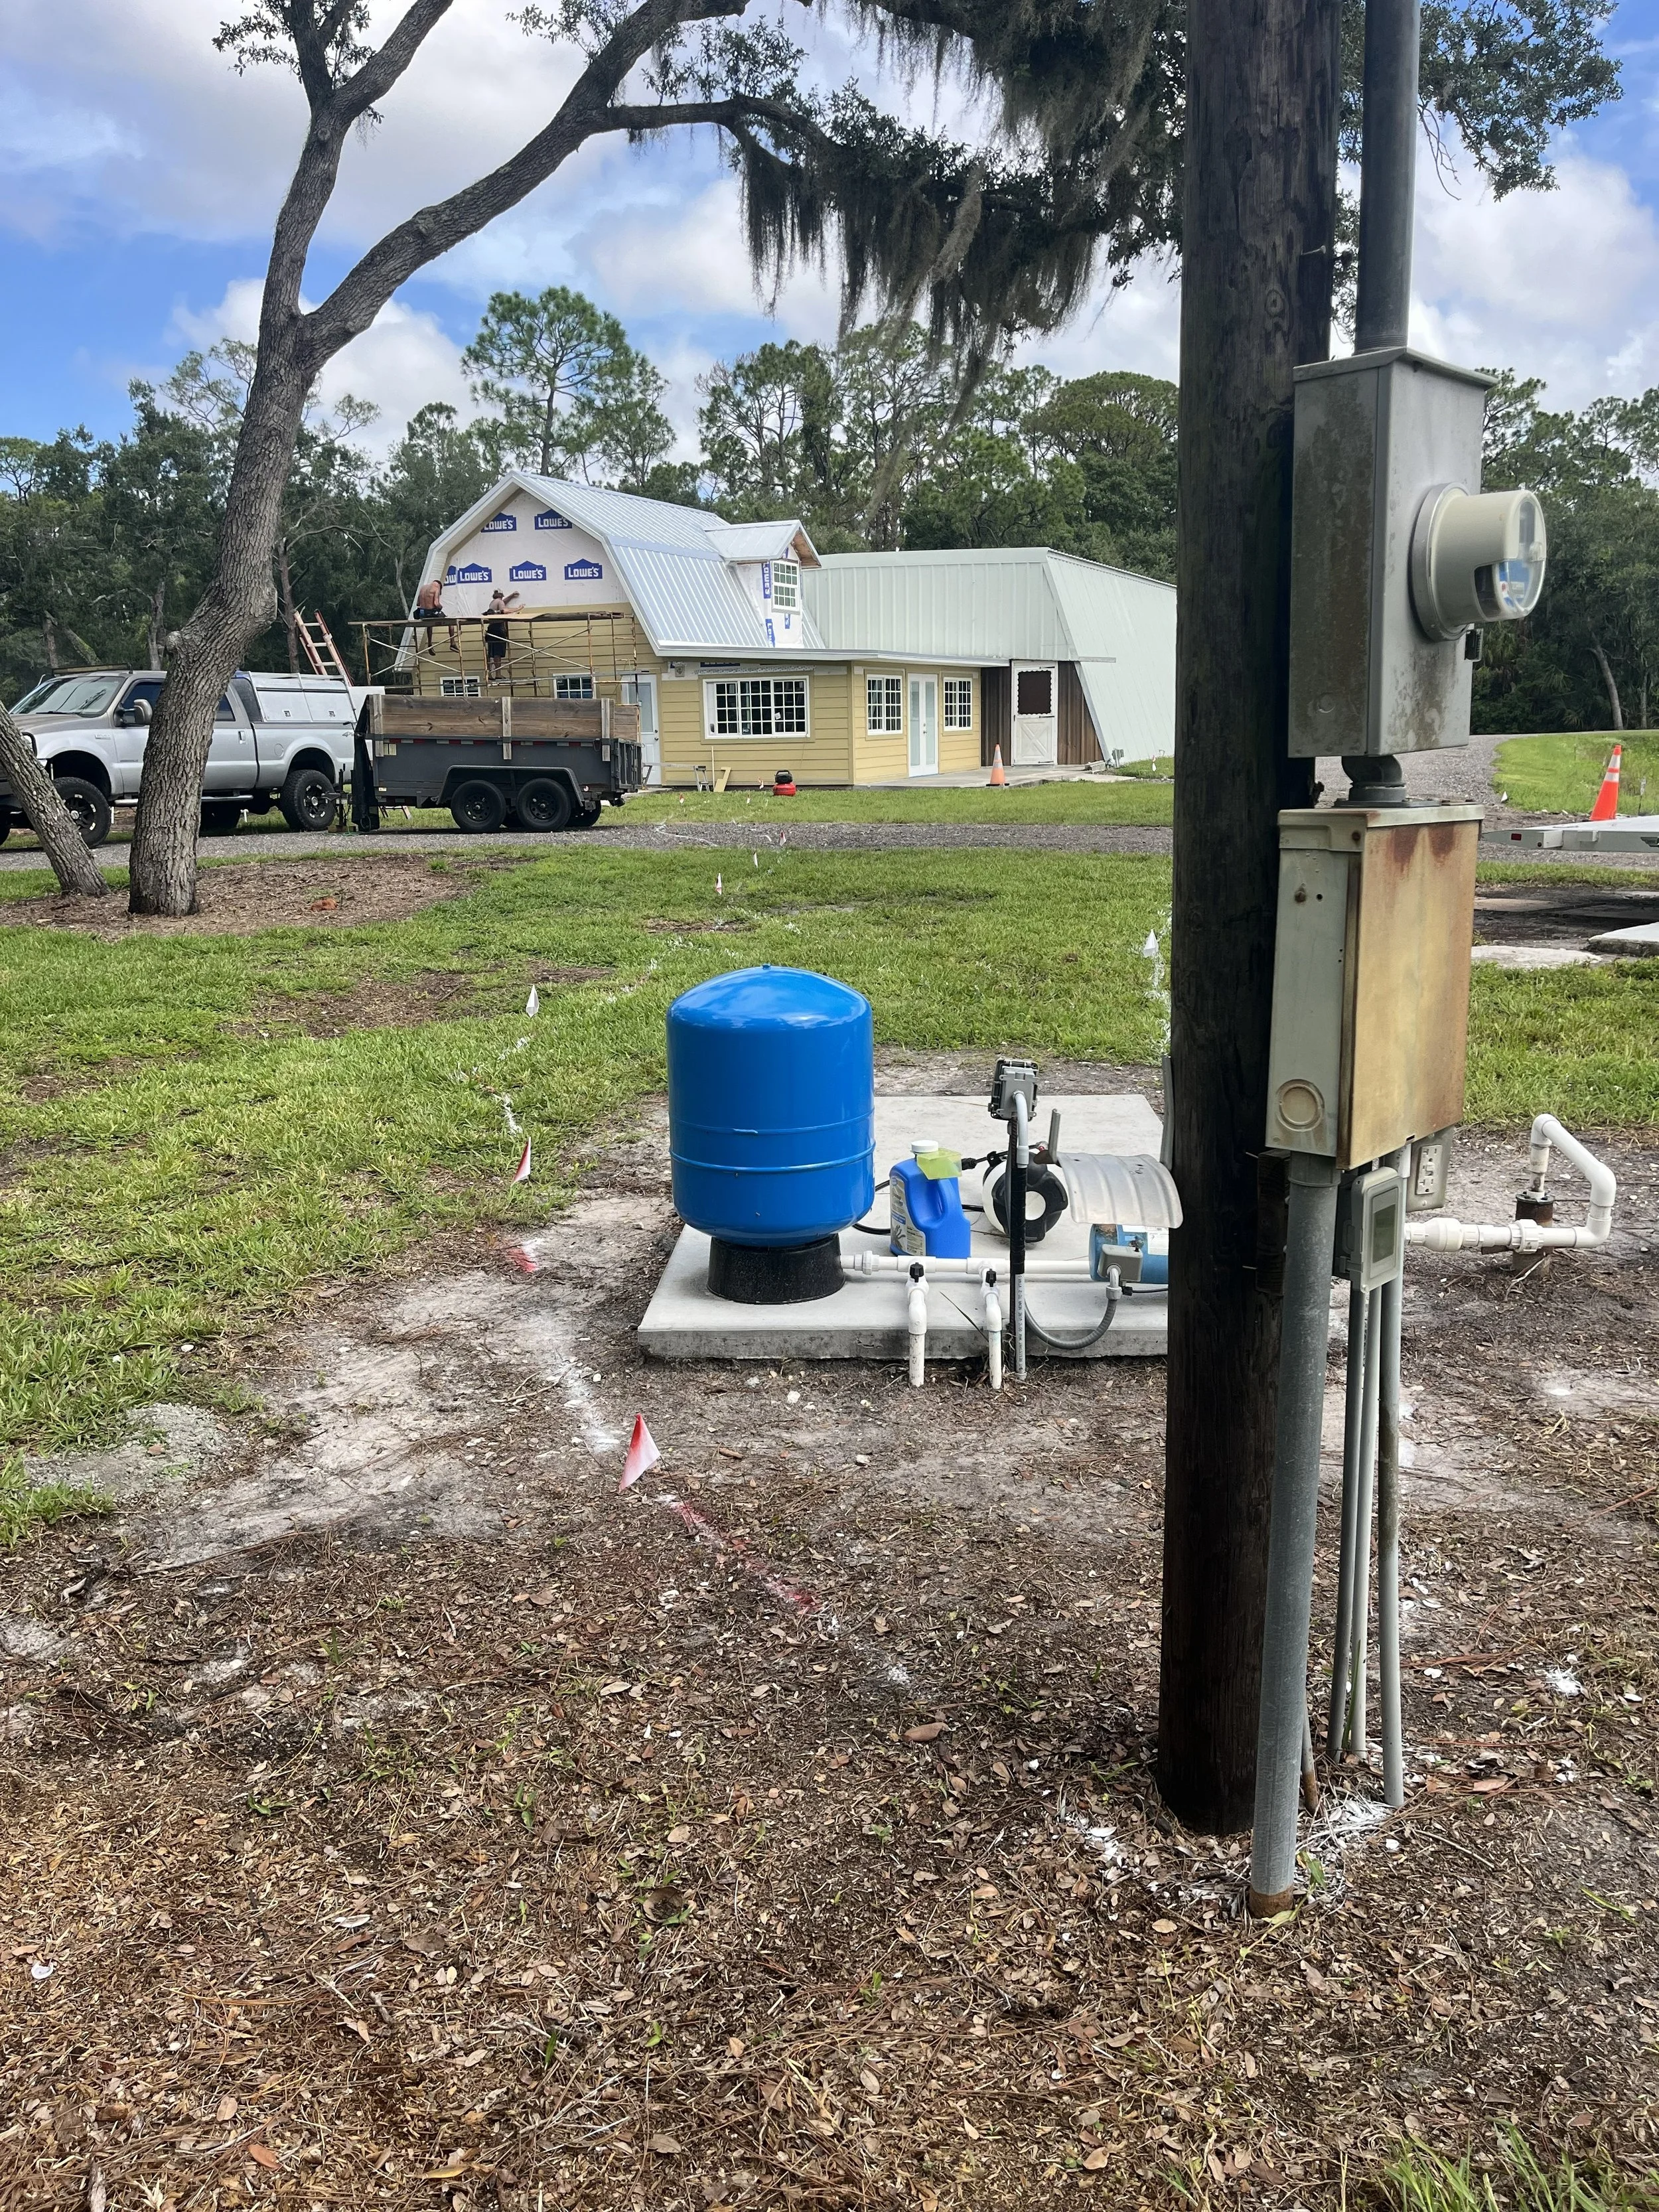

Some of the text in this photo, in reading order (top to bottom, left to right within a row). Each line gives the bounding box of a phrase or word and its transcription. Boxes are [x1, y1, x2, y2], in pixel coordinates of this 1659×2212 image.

[484, 519, 514, 530] LOWE'S
[538, 516, 569, 528] LOWE'S
[459, 569, 490, 581] LOWE'S
[512, 568, 543, 579] LOWE'S
[568, 566, 600, 578] LOWE'S
